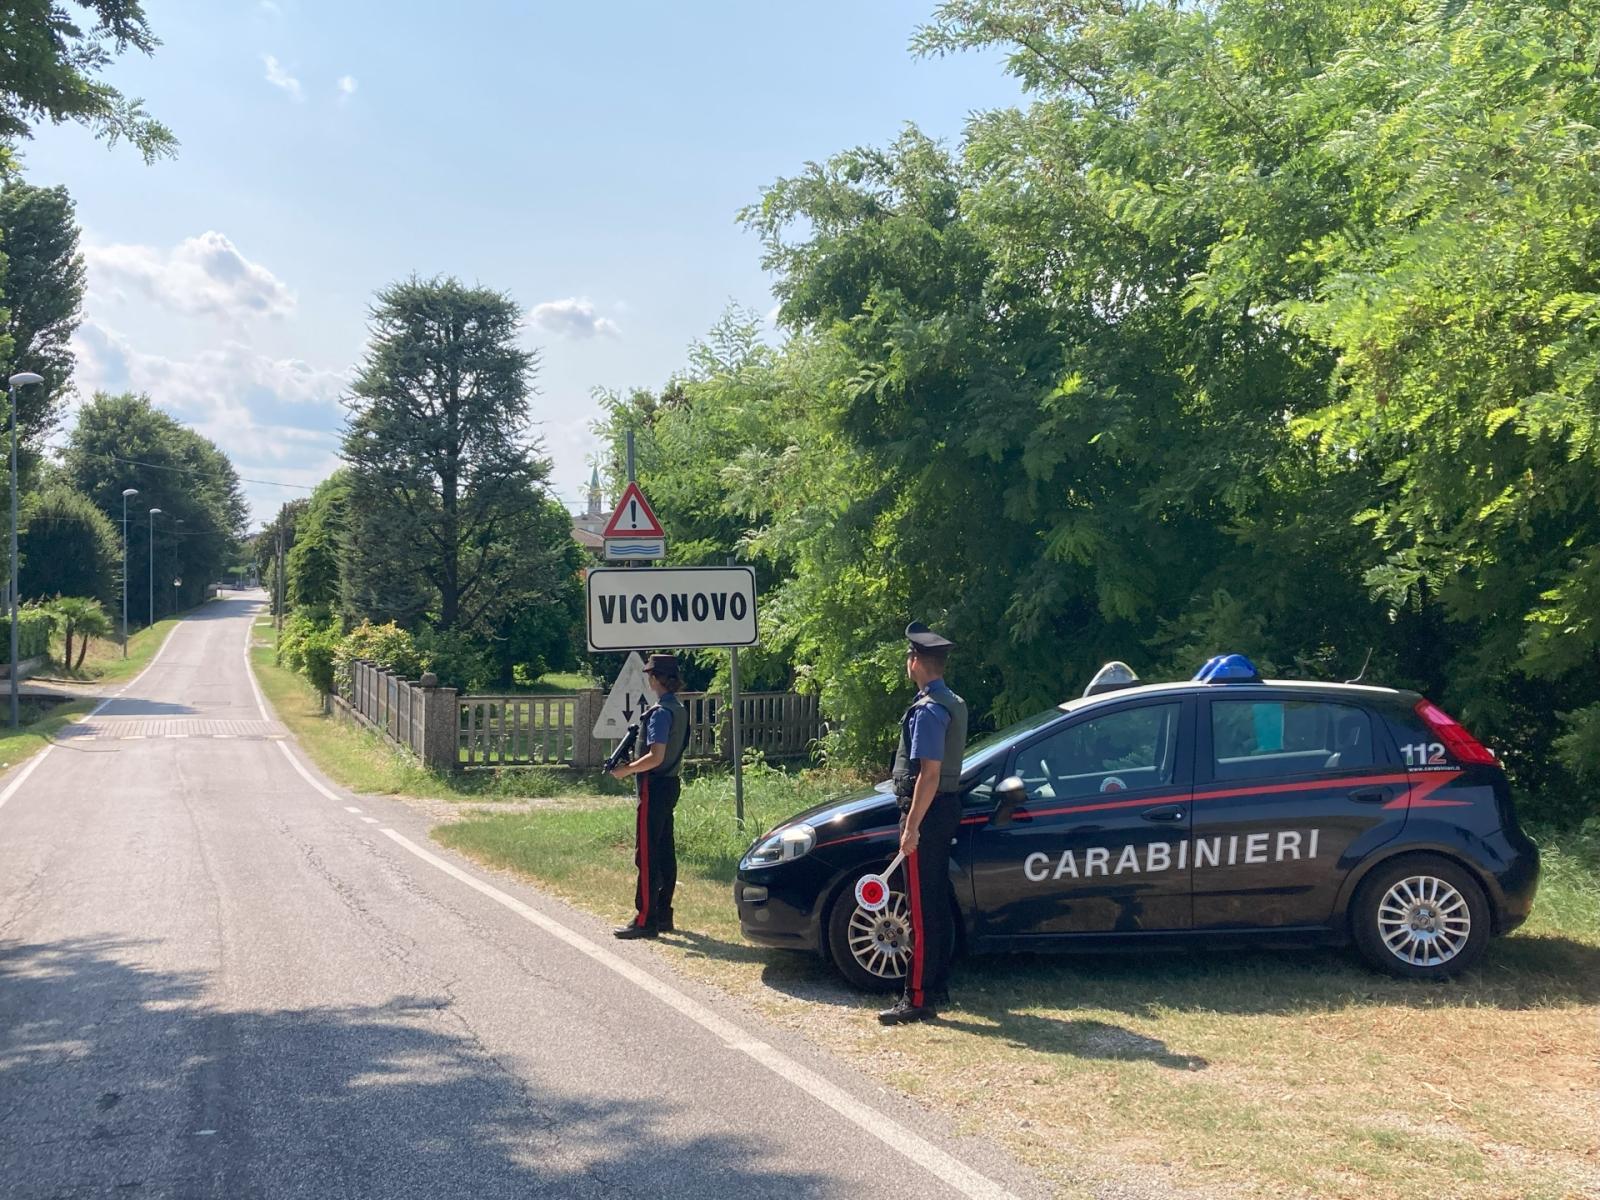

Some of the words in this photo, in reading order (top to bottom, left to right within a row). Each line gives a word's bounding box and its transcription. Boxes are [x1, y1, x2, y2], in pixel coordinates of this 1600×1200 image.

[598, 591, 747, 624] VIGONOVO
[1399, 742, 1447, 765] 112
[1024, 829, 1319, 882] CARABINIERI
